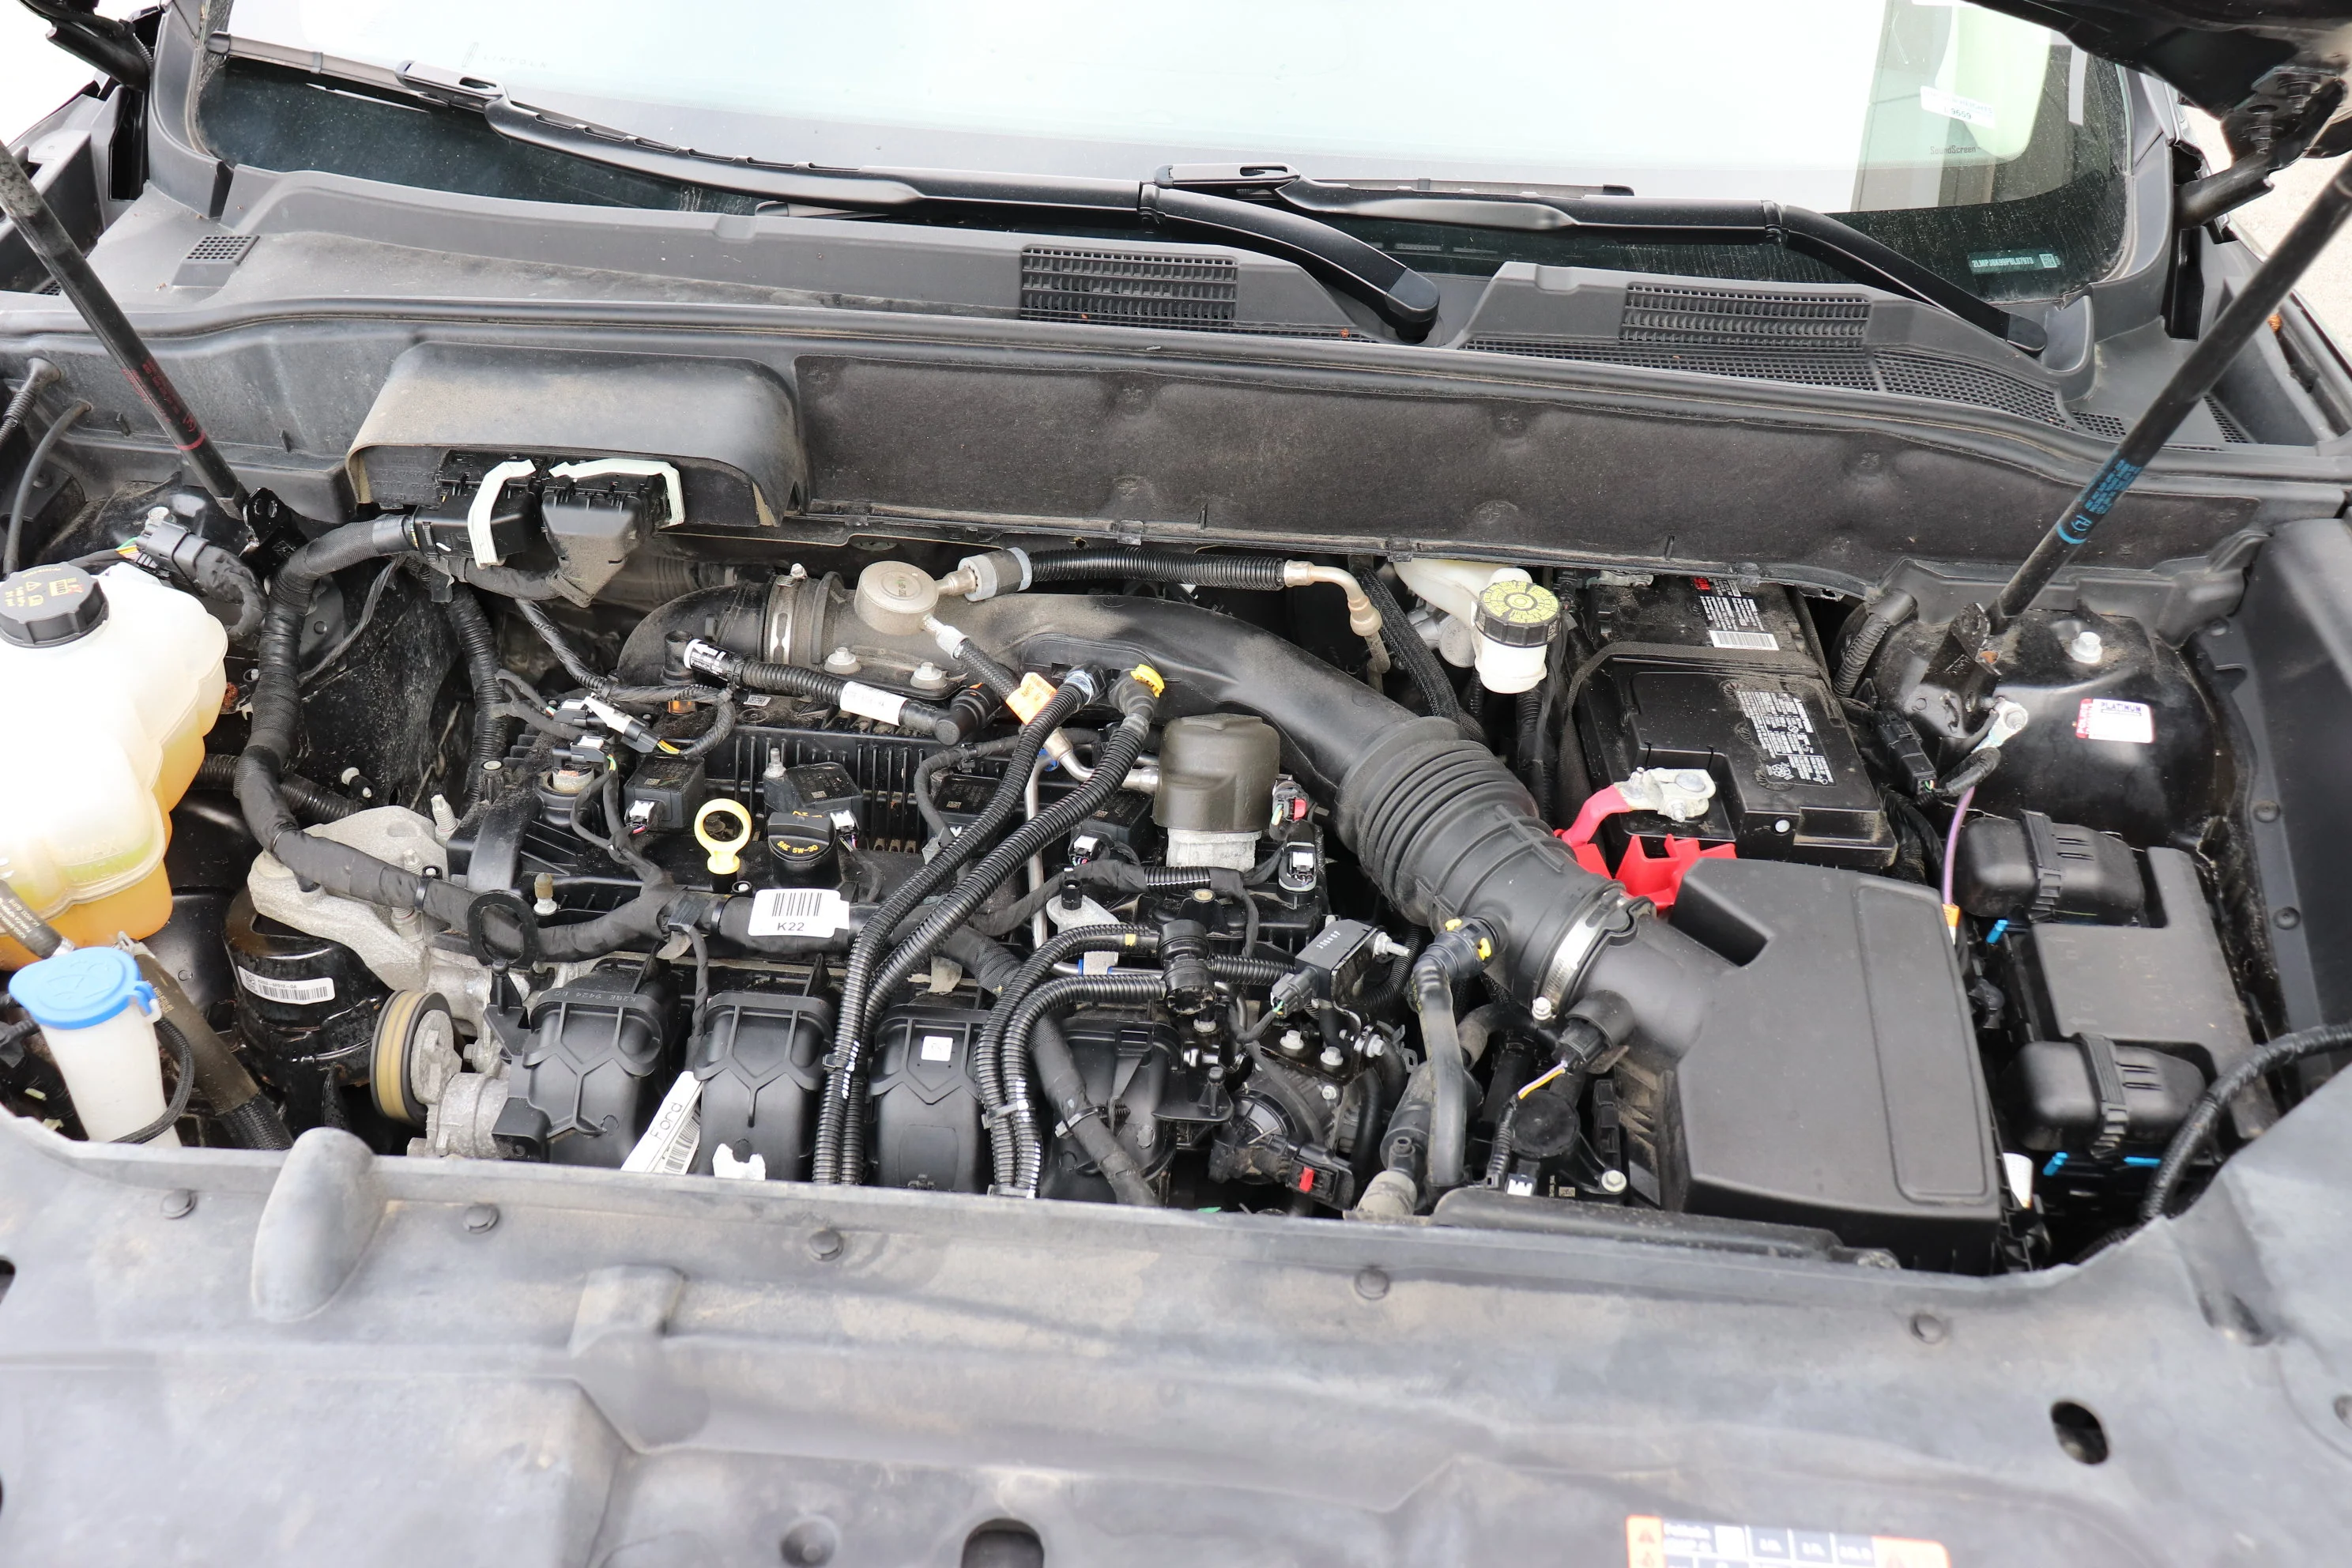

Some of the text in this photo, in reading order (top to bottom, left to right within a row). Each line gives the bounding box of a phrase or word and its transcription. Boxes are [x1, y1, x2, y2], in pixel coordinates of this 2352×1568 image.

[483, 55, 549, 69] LINCOLN
[1930, 145, 1977, 154] SoundScreen
[2101, 702, 2142, 713] PLATINUM
[777, 840, 819, 854] SAE 5W-30
[777, 921, 805, 932] K22
[649, 1101, 684, 1140] Ford
